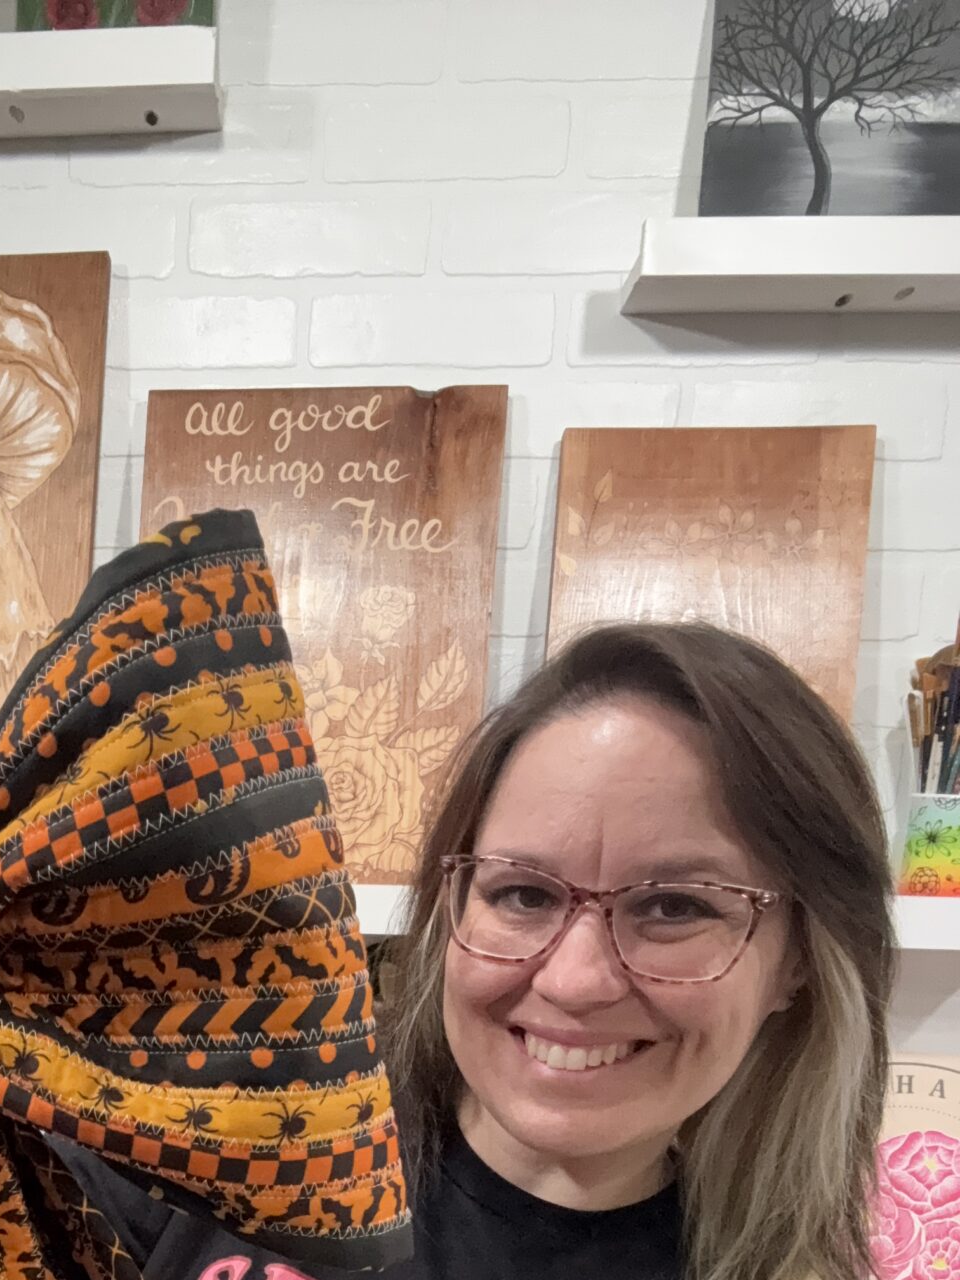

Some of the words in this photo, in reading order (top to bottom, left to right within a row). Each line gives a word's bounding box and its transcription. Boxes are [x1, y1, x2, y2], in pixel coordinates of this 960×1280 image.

[269, 394, 391, 453] good
[205, 451, 324, 498] things
[339, 459, 410, 484] are
[331, 497, 460, 553] Free
